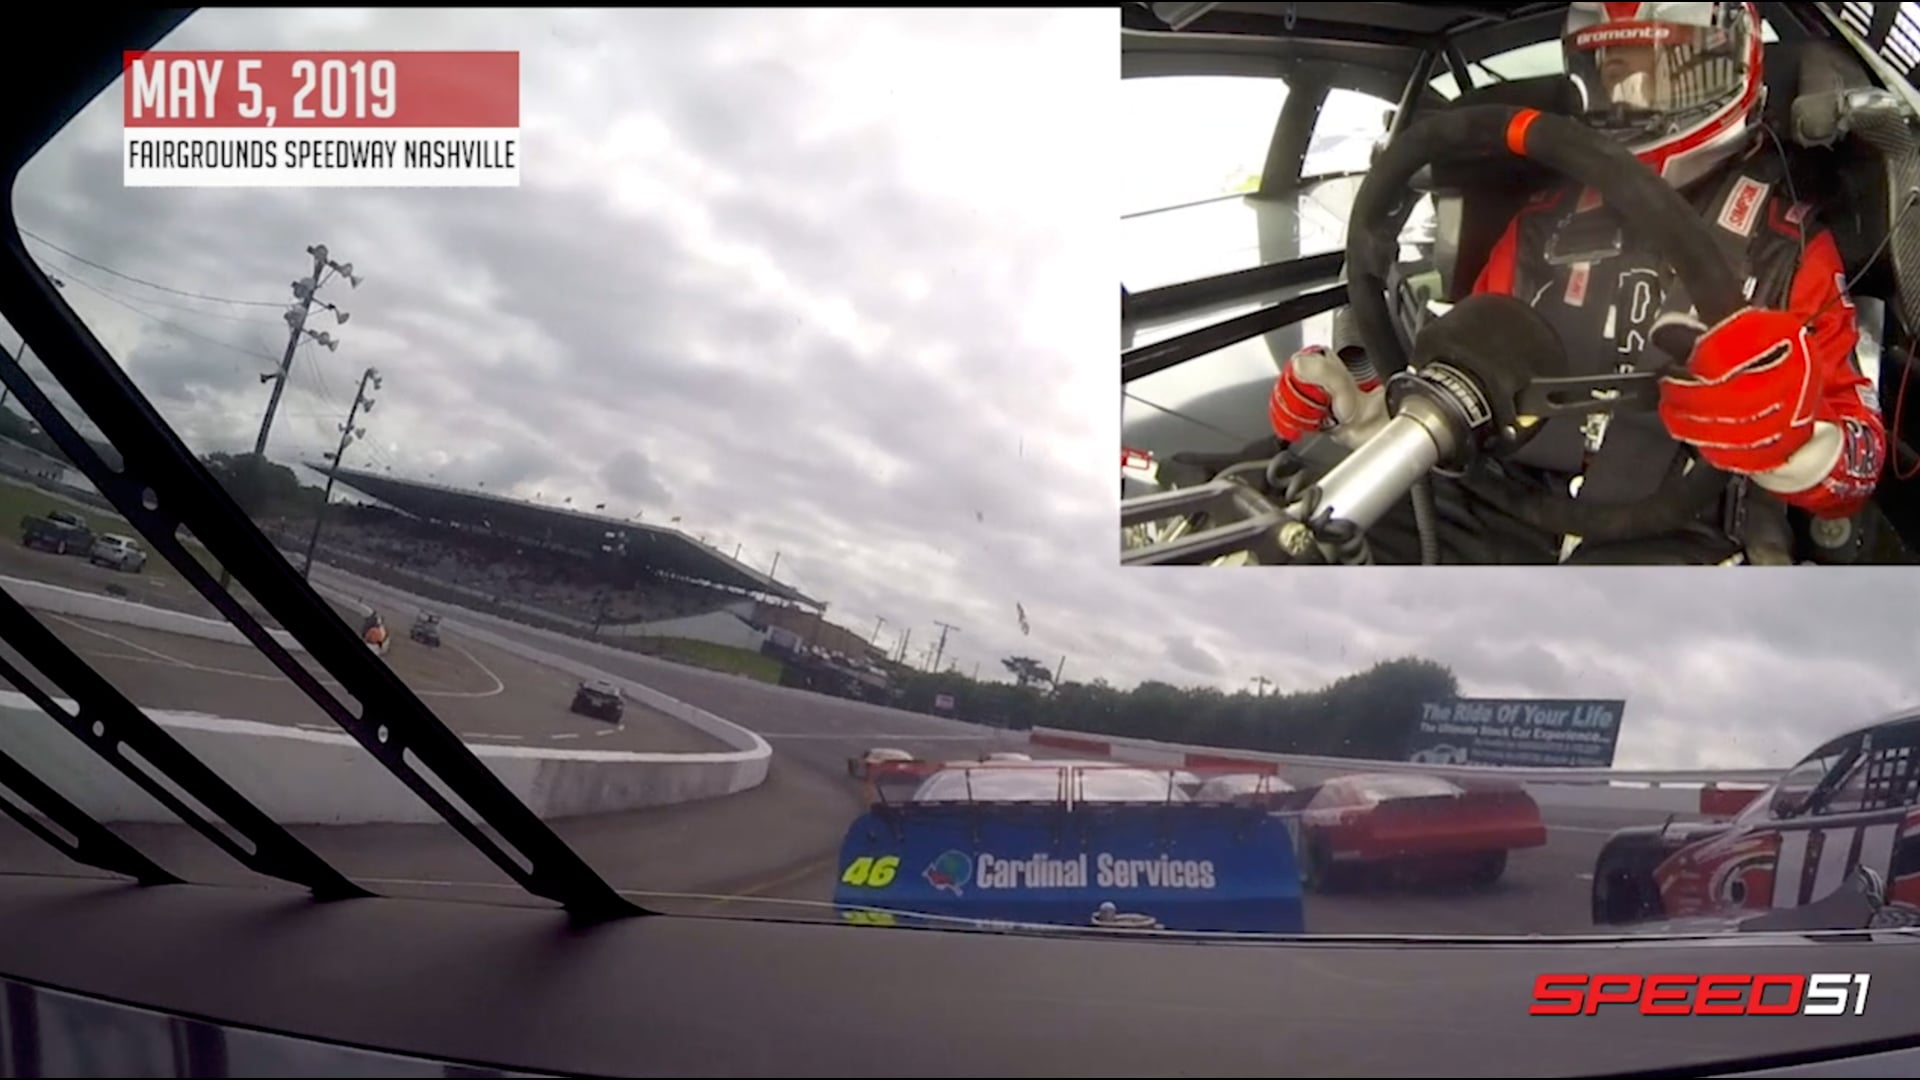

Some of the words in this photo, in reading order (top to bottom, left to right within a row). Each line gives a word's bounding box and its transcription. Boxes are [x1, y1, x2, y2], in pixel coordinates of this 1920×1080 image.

[1421, 703, 1450, 721] The
[1453, 703, 1493, 722] Ride
[1497, 704, 1520, 723] Of
[1524, 704, 1569, 727] Your
[1571, 704, 1614, 728] Life
[1420, 722, 1436, 733] The
[1512, 726, 1532, 738] Car
[842, 855, 900, 887] 46
[976, 853, 1087, 889] Cardinal
[1097, 853, 1216, 889] Services
